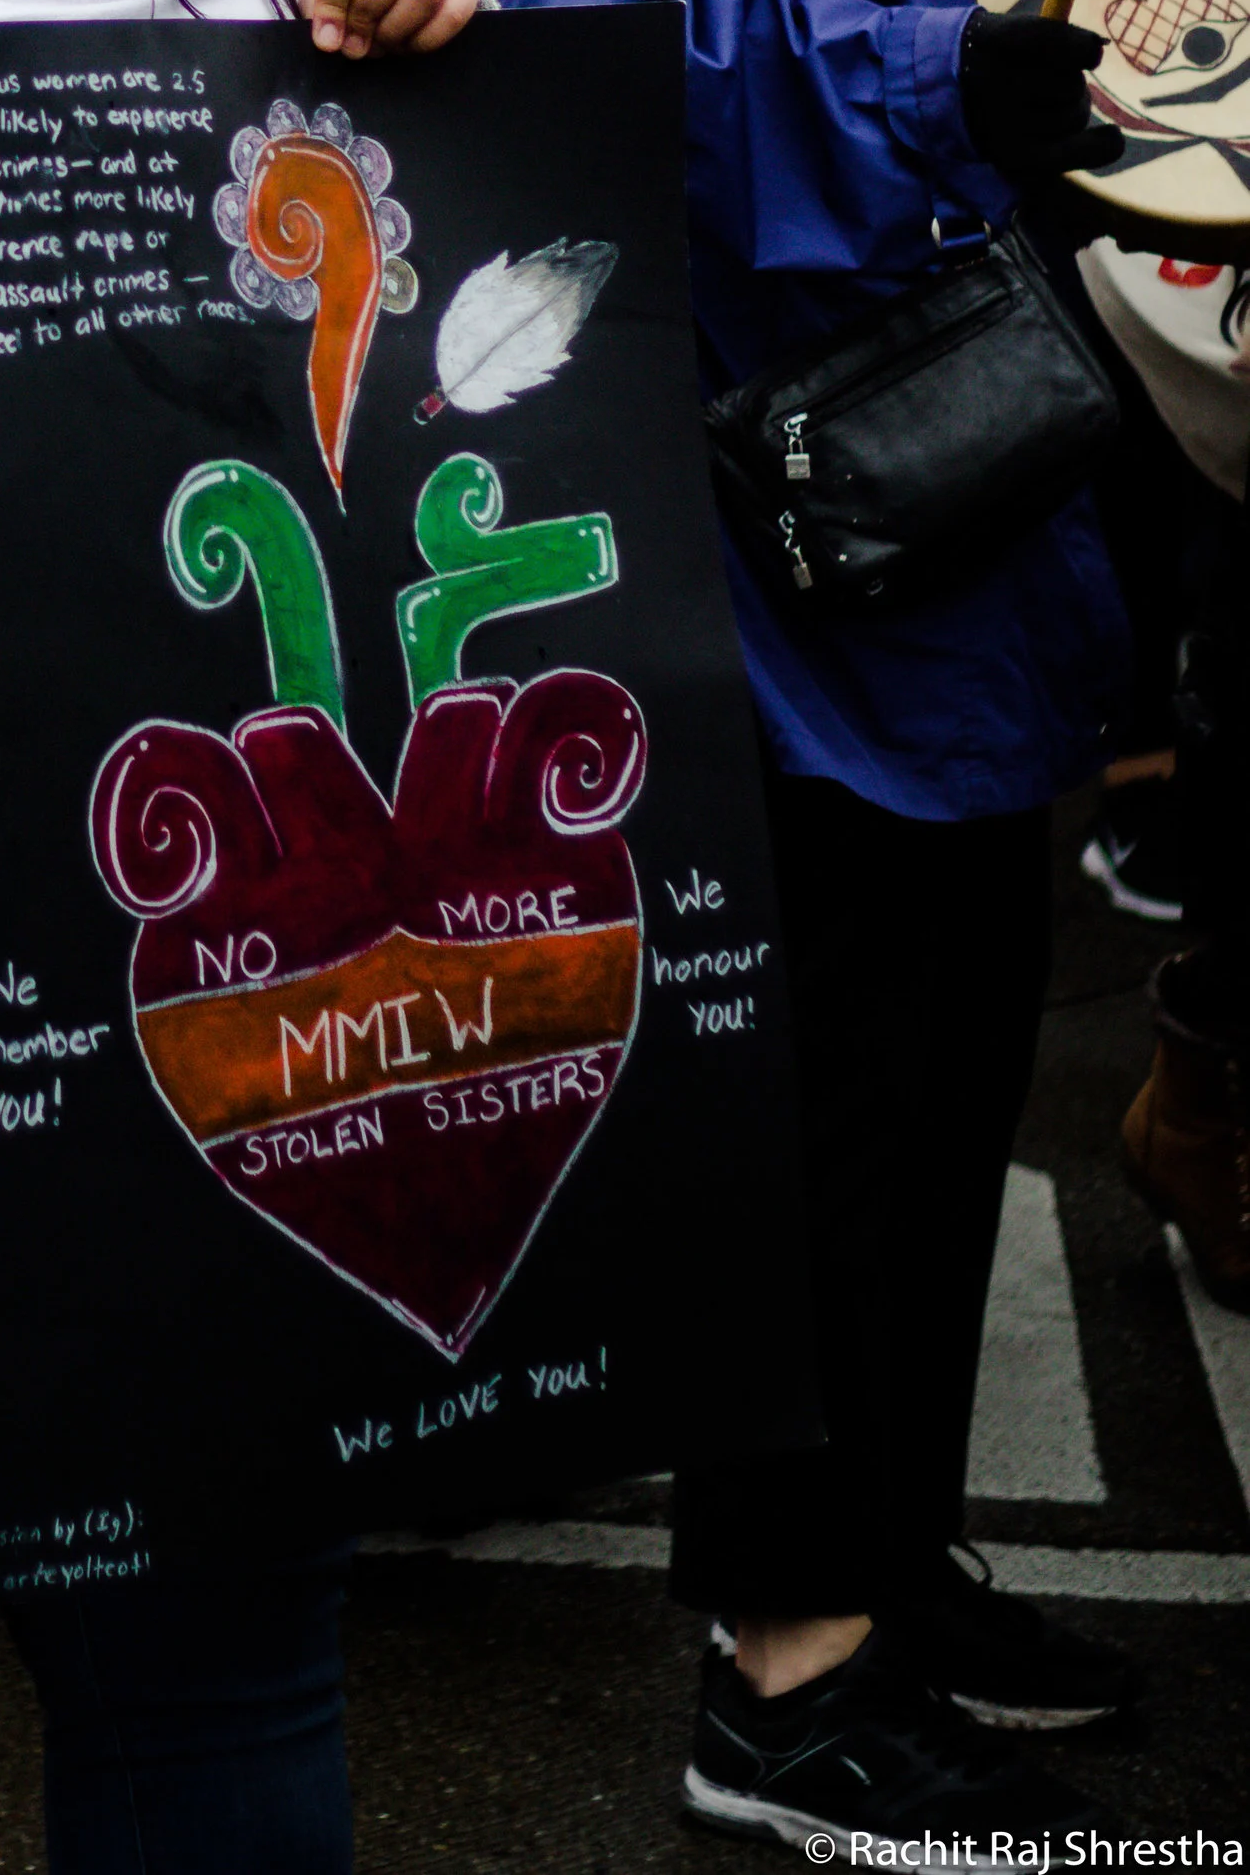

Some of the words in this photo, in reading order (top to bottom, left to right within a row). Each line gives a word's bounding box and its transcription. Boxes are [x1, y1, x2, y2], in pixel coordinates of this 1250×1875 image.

[31, 71, 118, 93] women
[121, 67, 162, 93] are
[171, 67, 206, 95] 2.5
[71, 104, 99, 127] to
[99, 148, 138, 176] and
[147, 149, 180, 174] at
[73, 190, 126, 212] more
[73, 229, 135, 263] rape
[144, 229, 170, 250] or
[92, 268, 171, 298] crimes
[33, 317, 62, 346] to
[74, 306, 107, 336] all
[117, 302, 187, 329] other
[664, 868, 725, 916] We
[194, 930, 282, 987] NO
[438, 884, 580, 937] MORE
[651, 942, 770, 986] honour
[275, 976, 493, 1099] MMIW
[239, 1110, 384, 1177] STOLEN
[423, 1051, 605, 1133] SISTERS
[333, 1418, 393, 1462] We
[416, 1373, 502, 1439] LOVE
[53, 1517, 75, 1546] by
